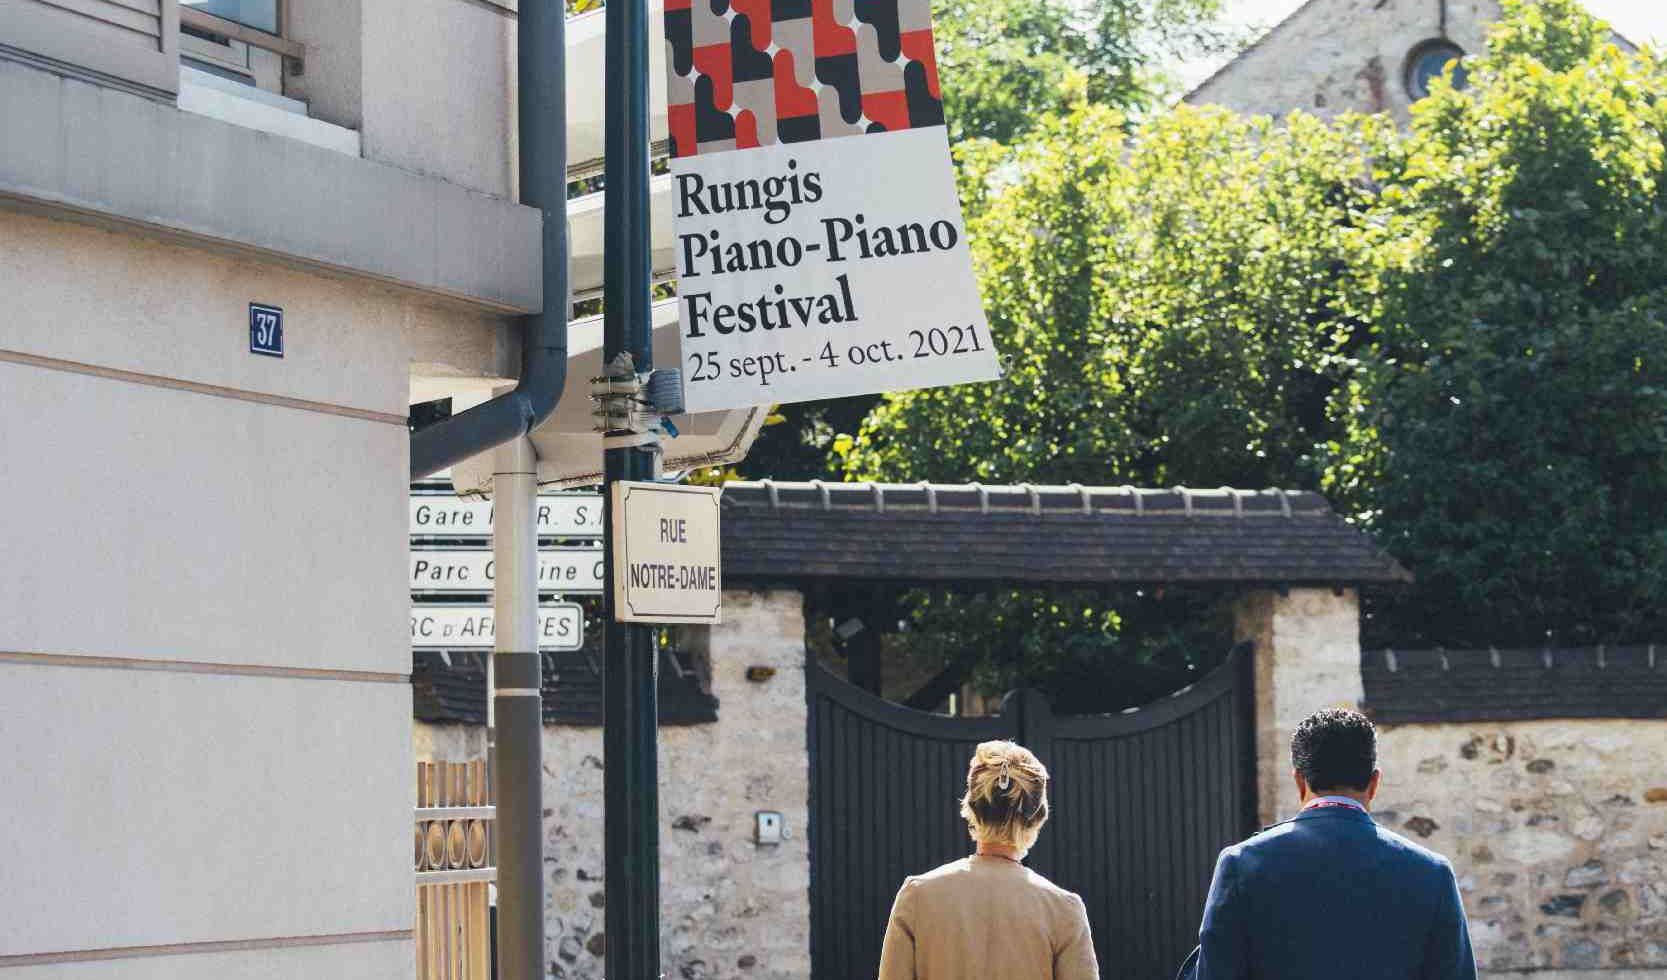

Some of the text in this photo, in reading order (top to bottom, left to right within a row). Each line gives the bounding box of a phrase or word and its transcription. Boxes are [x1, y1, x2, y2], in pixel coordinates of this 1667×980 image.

[675, 159, 823, 224] Rungis
[679, 213, 958, 278] Piano-Piano
[683, 274, 858, 338] Festival
[256, 313, 277, 346] 37
[688, 351, 721, 382] 25
[729, 350, 796, 386] sept.
[819, 341, 840, 368] 4
[849, 340, 904, 365] oct.
[908, 324, 985, 358] 2021
[416, 505, 474, 526] Gare
[574, 505, 603, 526] S.
[660, 518, 687, 543] RUE
[414, 560, 469, 581] Parc
[631, 563, 716, 590] NOTRE-DAME
